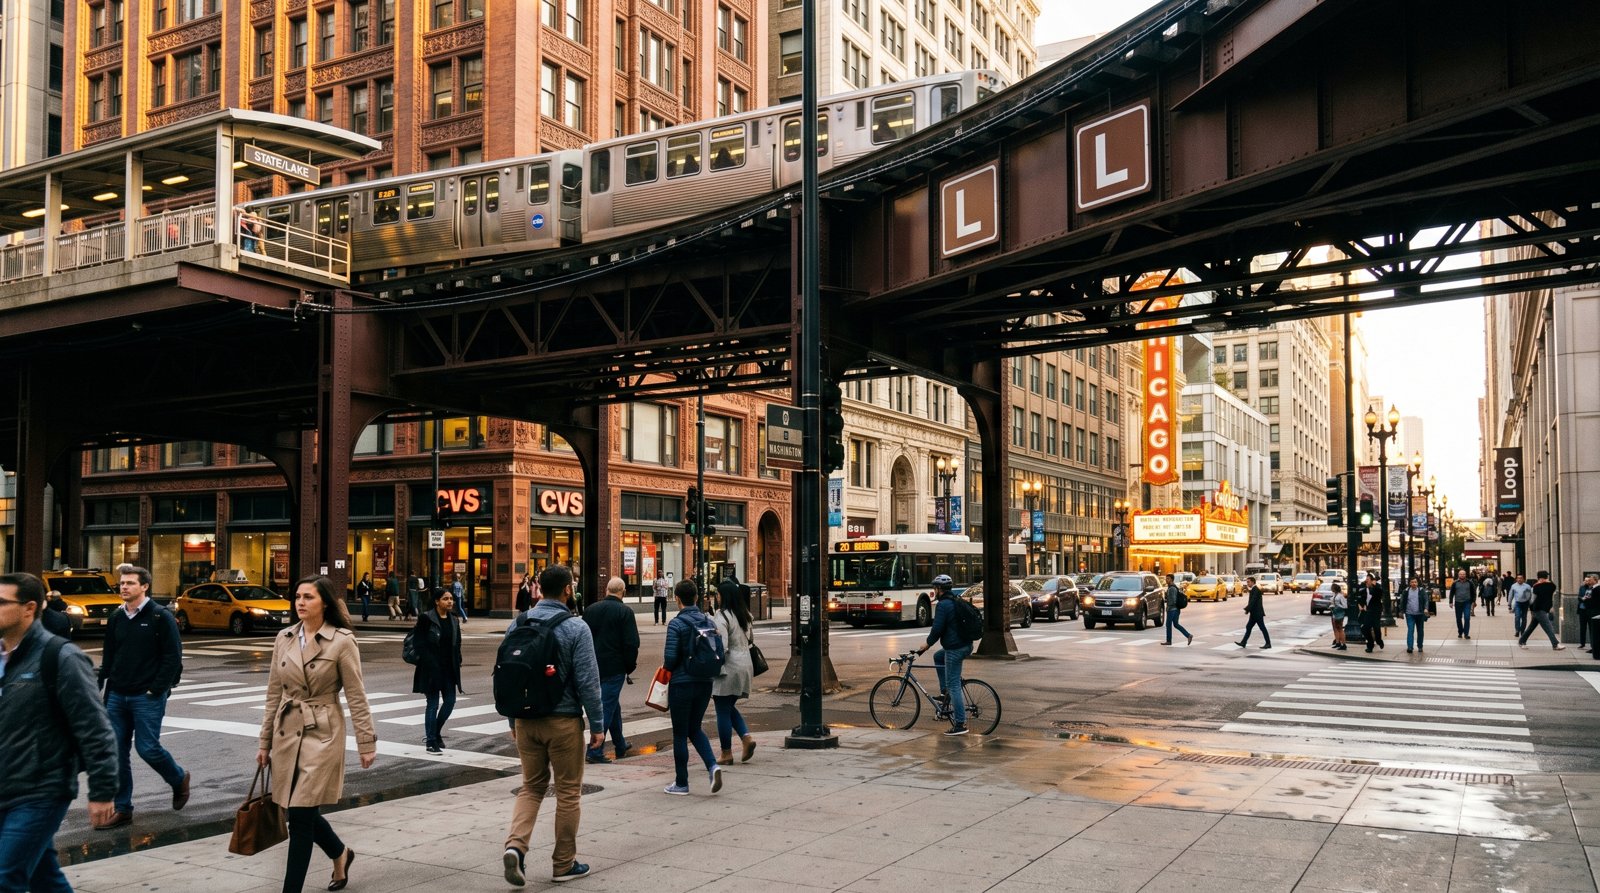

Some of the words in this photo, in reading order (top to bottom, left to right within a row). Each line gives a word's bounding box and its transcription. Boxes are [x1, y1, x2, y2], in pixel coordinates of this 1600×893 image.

[254, 150, 310, 178] STATE/LAKE
[1095, 133, 1128, 190] L
[956, 189, 982, 239] L
[769, 444, 802, 458] WASHINGTON
[1500, 457, 1519, 499] Loop
[541, 490, 583, 515] CVS
[840, 542, 850, 552] 20
